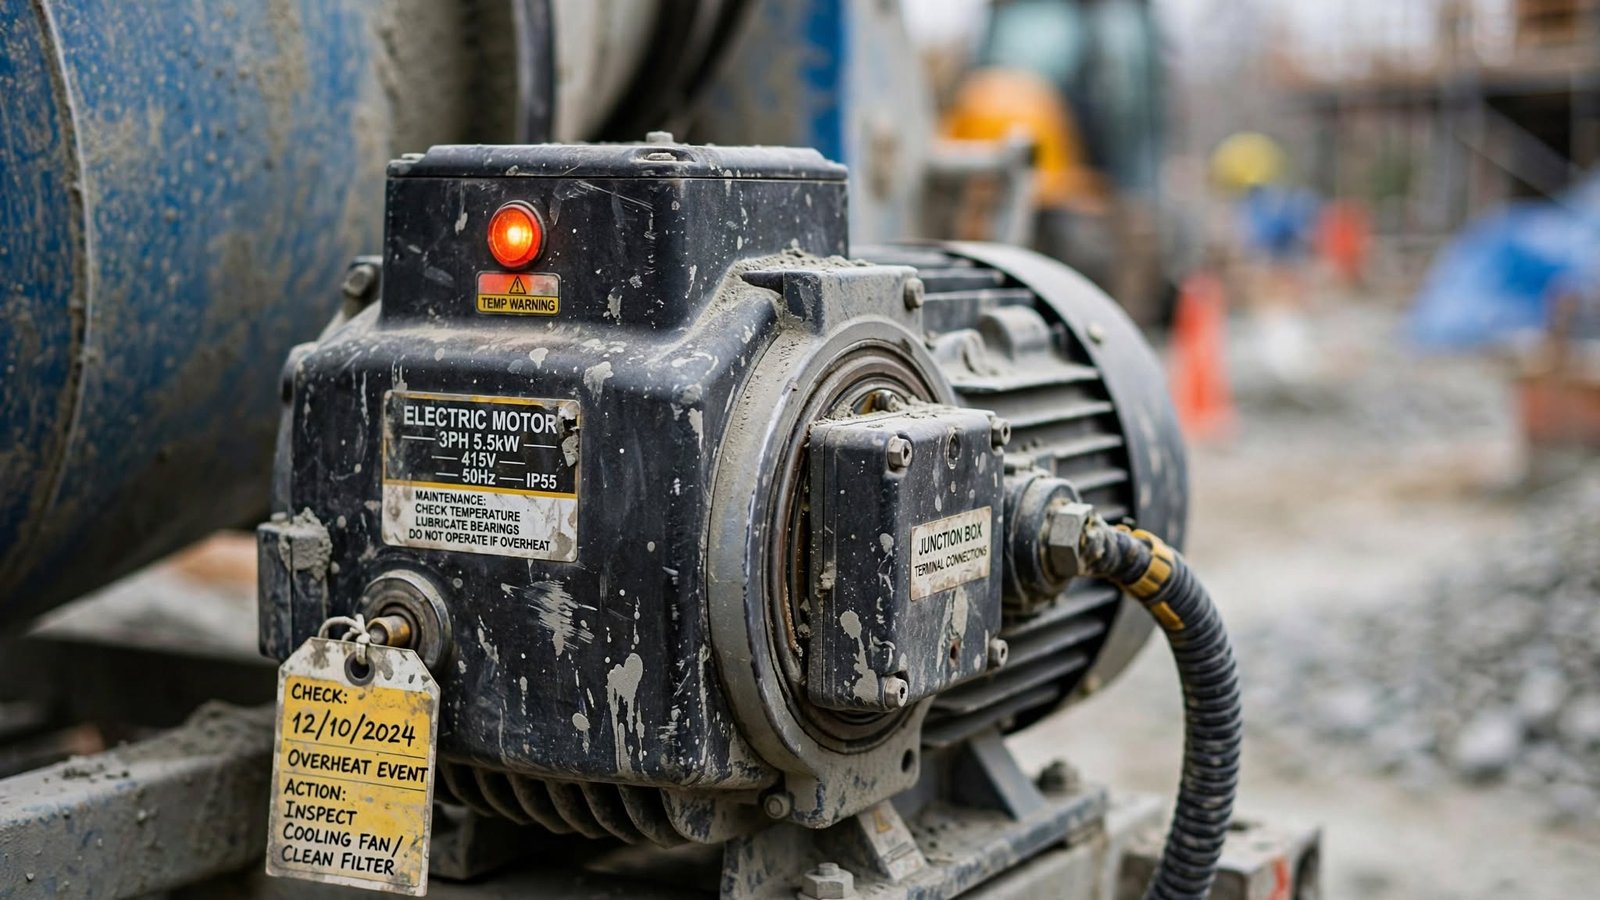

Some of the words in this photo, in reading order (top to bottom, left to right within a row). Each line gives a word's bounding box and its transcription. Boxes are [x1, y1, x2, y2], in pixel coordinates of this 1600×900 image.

[482, 297, 507, 309] TEMP
[510, 298, 555, 311] WARNING
[403, 405, 487, 430] ELECTRIC
[492, 410, 557, 434] MOTOR
[439, 431, 469, 449] 3PH
[473, 434, 520, 453] 5.5kW
[461, 452, 496, 468] 415V
[462, 468, 496, 486] 50Hz
[526, 472, 557, 490] IP55
[415, 490, 486, 506] MAINTENANCE:
[415, 503, 448, 517] CHECK
[450, 506, 521, 522] TEMPERATURE
[416, 516, 468, 531] LUBRICATE
[470, 520, 520, 536] BEARINGS
[409, 529, 423, 540] DO
[425, 530, 444, 541] NOT
[445, 532, 488, 546] OPERATE
[490, 535, 498, 547] IF
[500, 537, 550, 551] OVERHEAT
[919, 527, 962, 556] JUNCTION
[965, 521, 982, 542] BOX
[914, 558, 944, 577] TERMINAL
[945, 545, 987, 568] CONNECTIONS
[291, 683, 348, 704] CHECK:
[292, 709, 416, 747] 12/10/2024
[288, 749, 372, 775] OVERHEAT
[377, 762, 428, 783] EVENT
[284, 778, 347, 801] ACTION:
[284, 800, 357, 825] INSPECT
[283, 822, 351, 847] COOLING
[281, 845, 334, 866] CLEAN
[341, 852, 395, 875] FILTER
